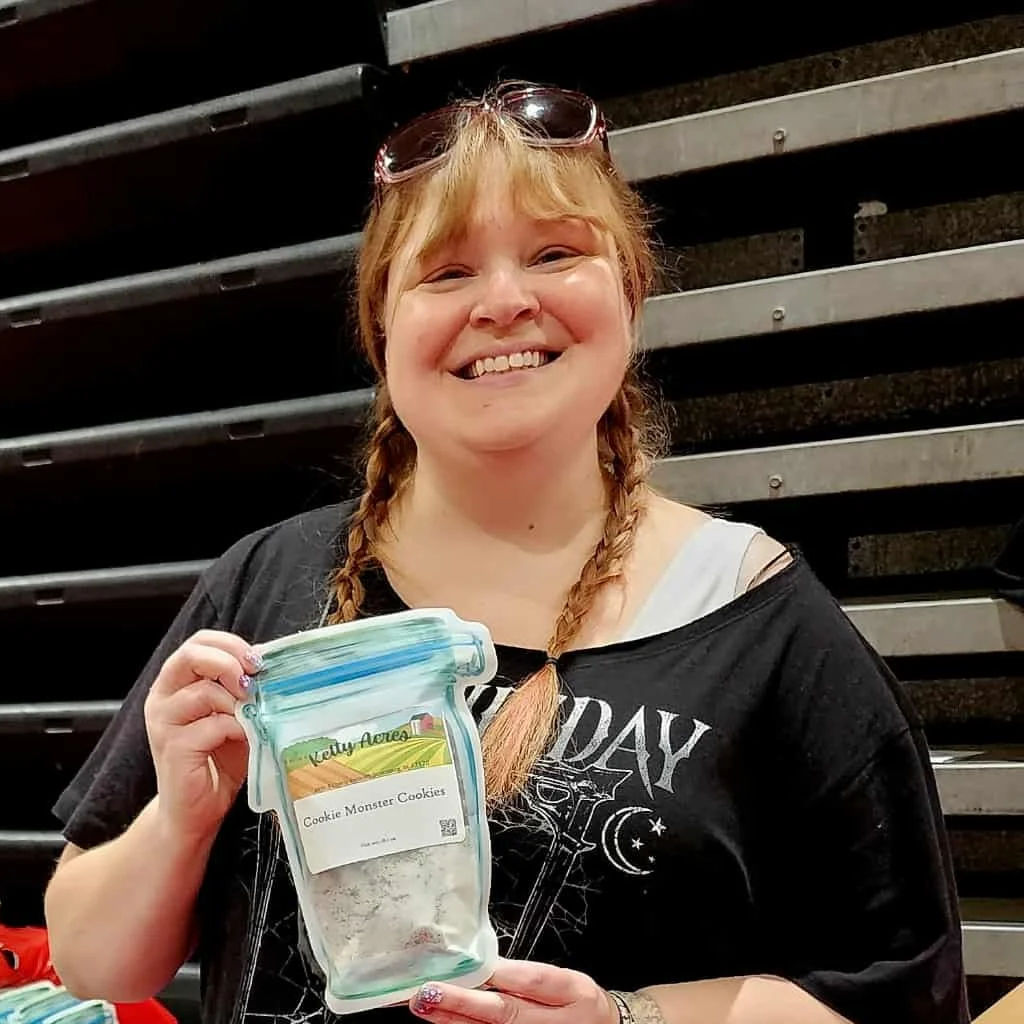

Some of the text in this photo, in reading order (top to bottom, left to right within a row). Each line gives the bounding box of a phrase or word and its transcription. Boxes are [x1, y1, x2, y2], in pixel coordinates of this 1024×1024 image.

[360, 729, 412, 749] Acres
[303, 787, 446, 828] Cookie Monster Cookies
